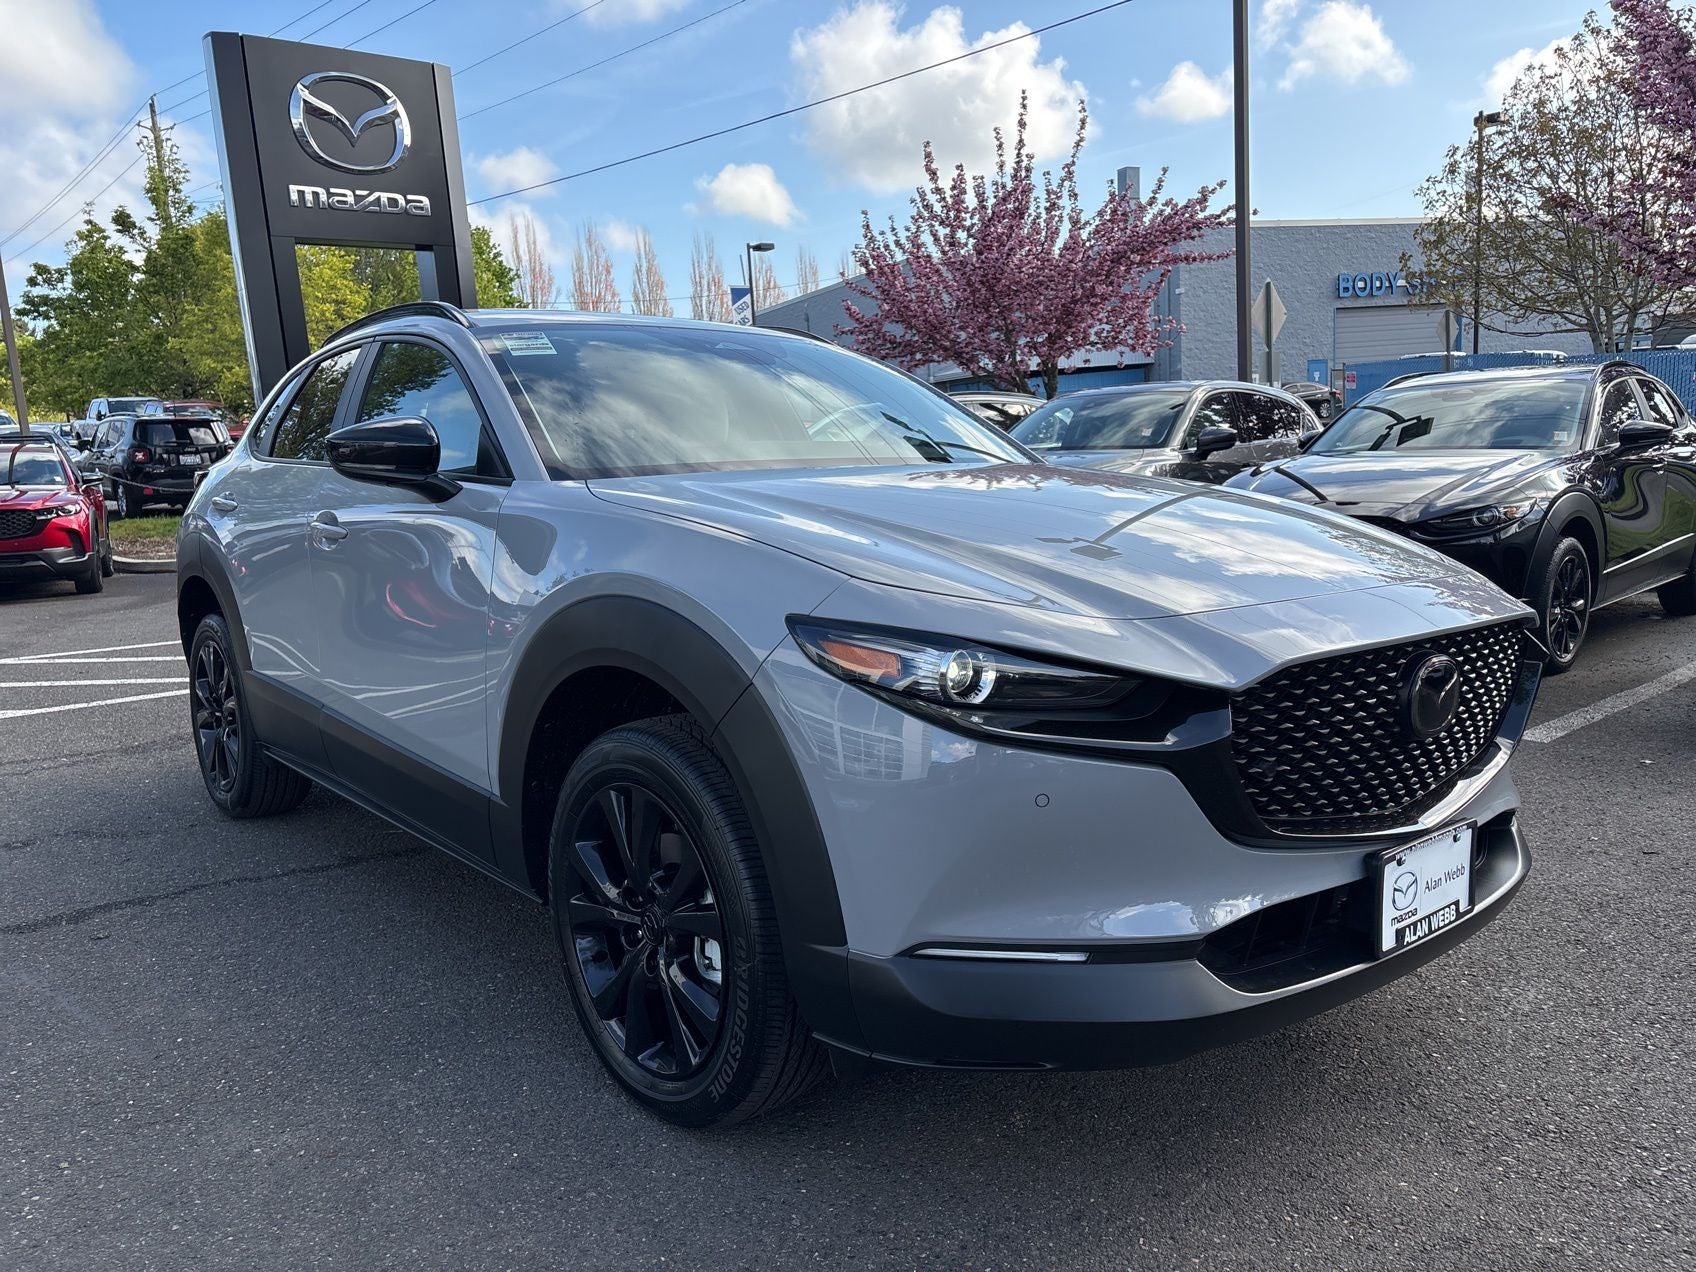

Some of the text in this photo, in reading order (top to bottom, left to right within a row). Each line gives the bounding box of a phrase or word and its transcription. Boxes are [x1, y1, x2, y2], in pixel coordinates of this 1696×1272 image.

[1337, 271, 1401, 298] BODY
[1424, 863, 1466, 895] Alan Webb
[1403, 905, 1457, 946] ALAN WEBB
